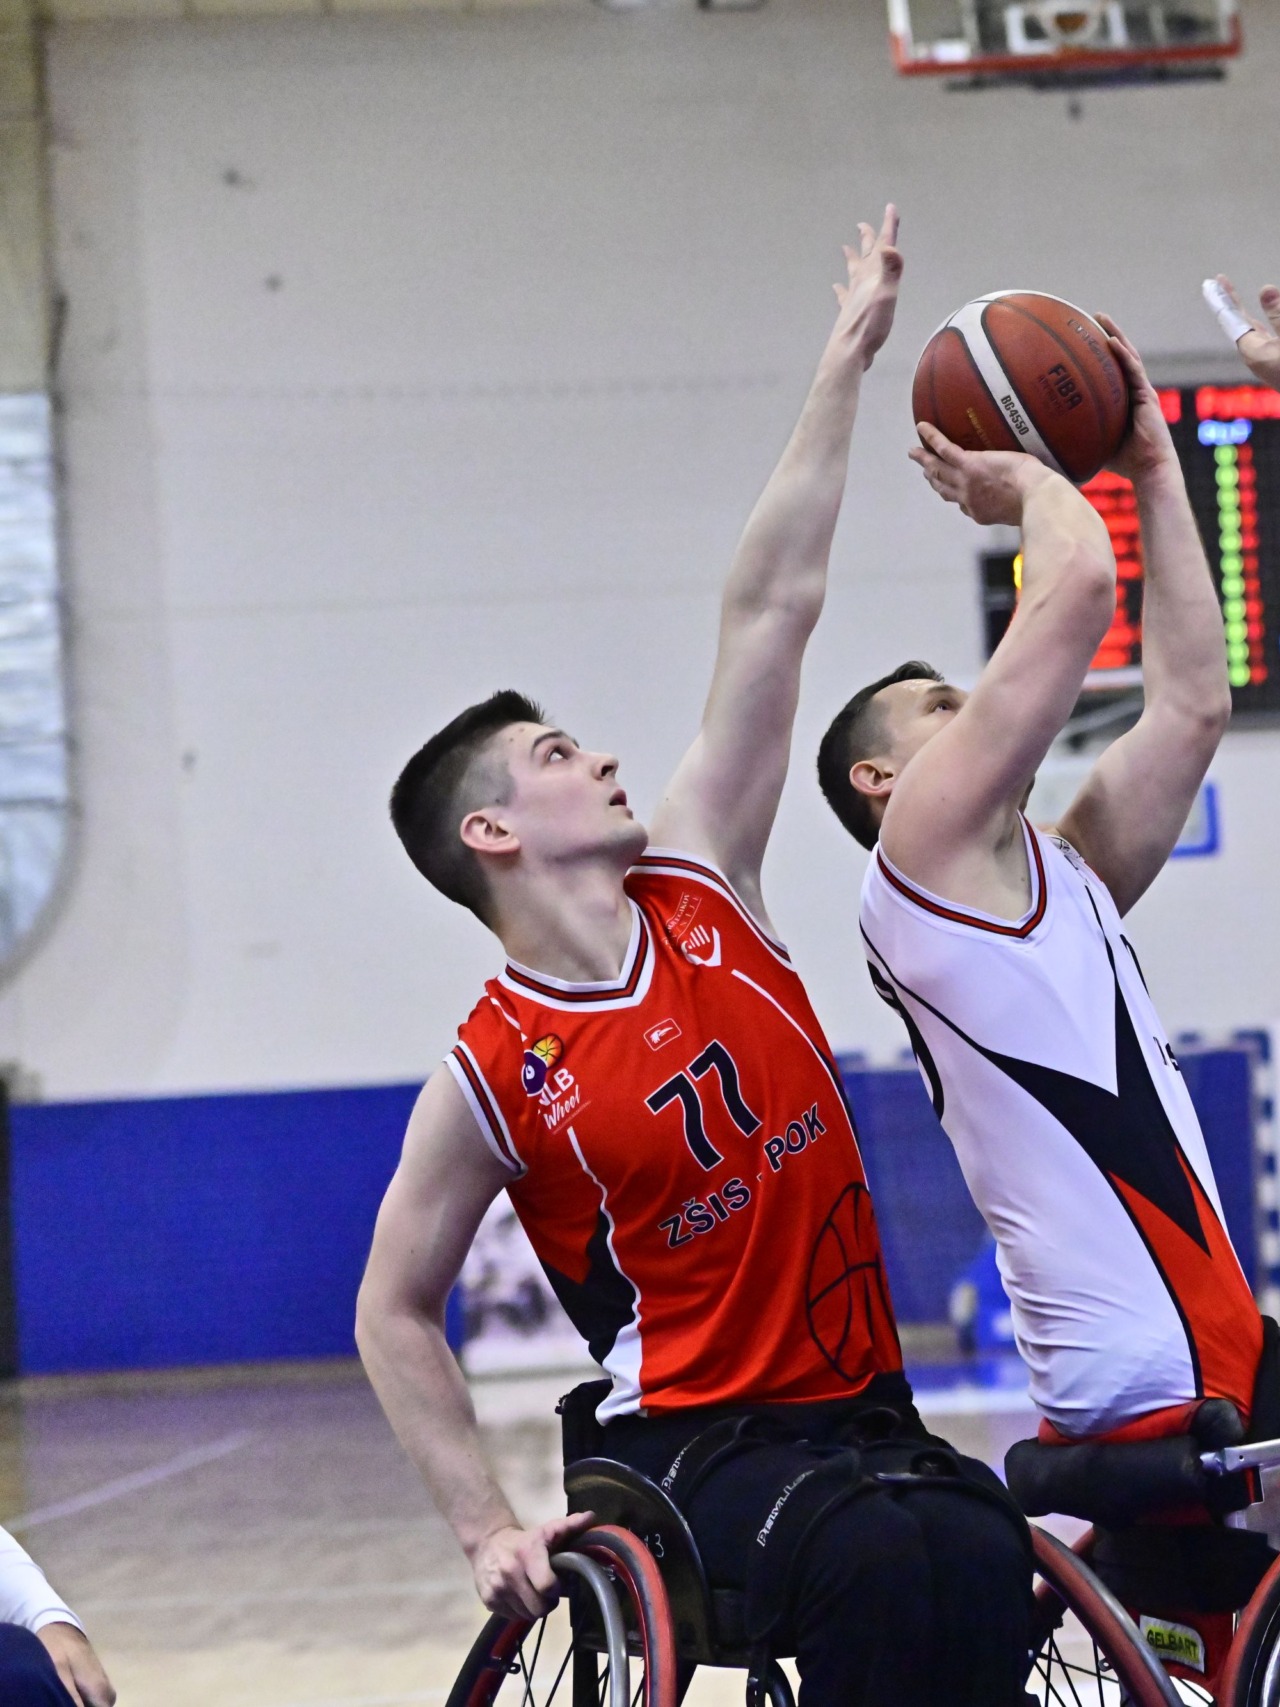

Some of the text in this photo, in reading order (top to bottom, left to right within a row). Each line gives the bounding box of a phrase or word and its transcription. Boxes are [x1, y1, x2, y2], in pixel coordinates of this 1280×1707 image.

[1049, 364, 1083, 409] FIBA
[1000, 394, 1030, 437] BG4550
[543, 1083, 581, 1131] Wheel
[645, 1038, 764, 1173] 77
[657, 1101, 827, 1250] ZŠIS POK
[1146, 1628, 1199, 1660] GELBART
